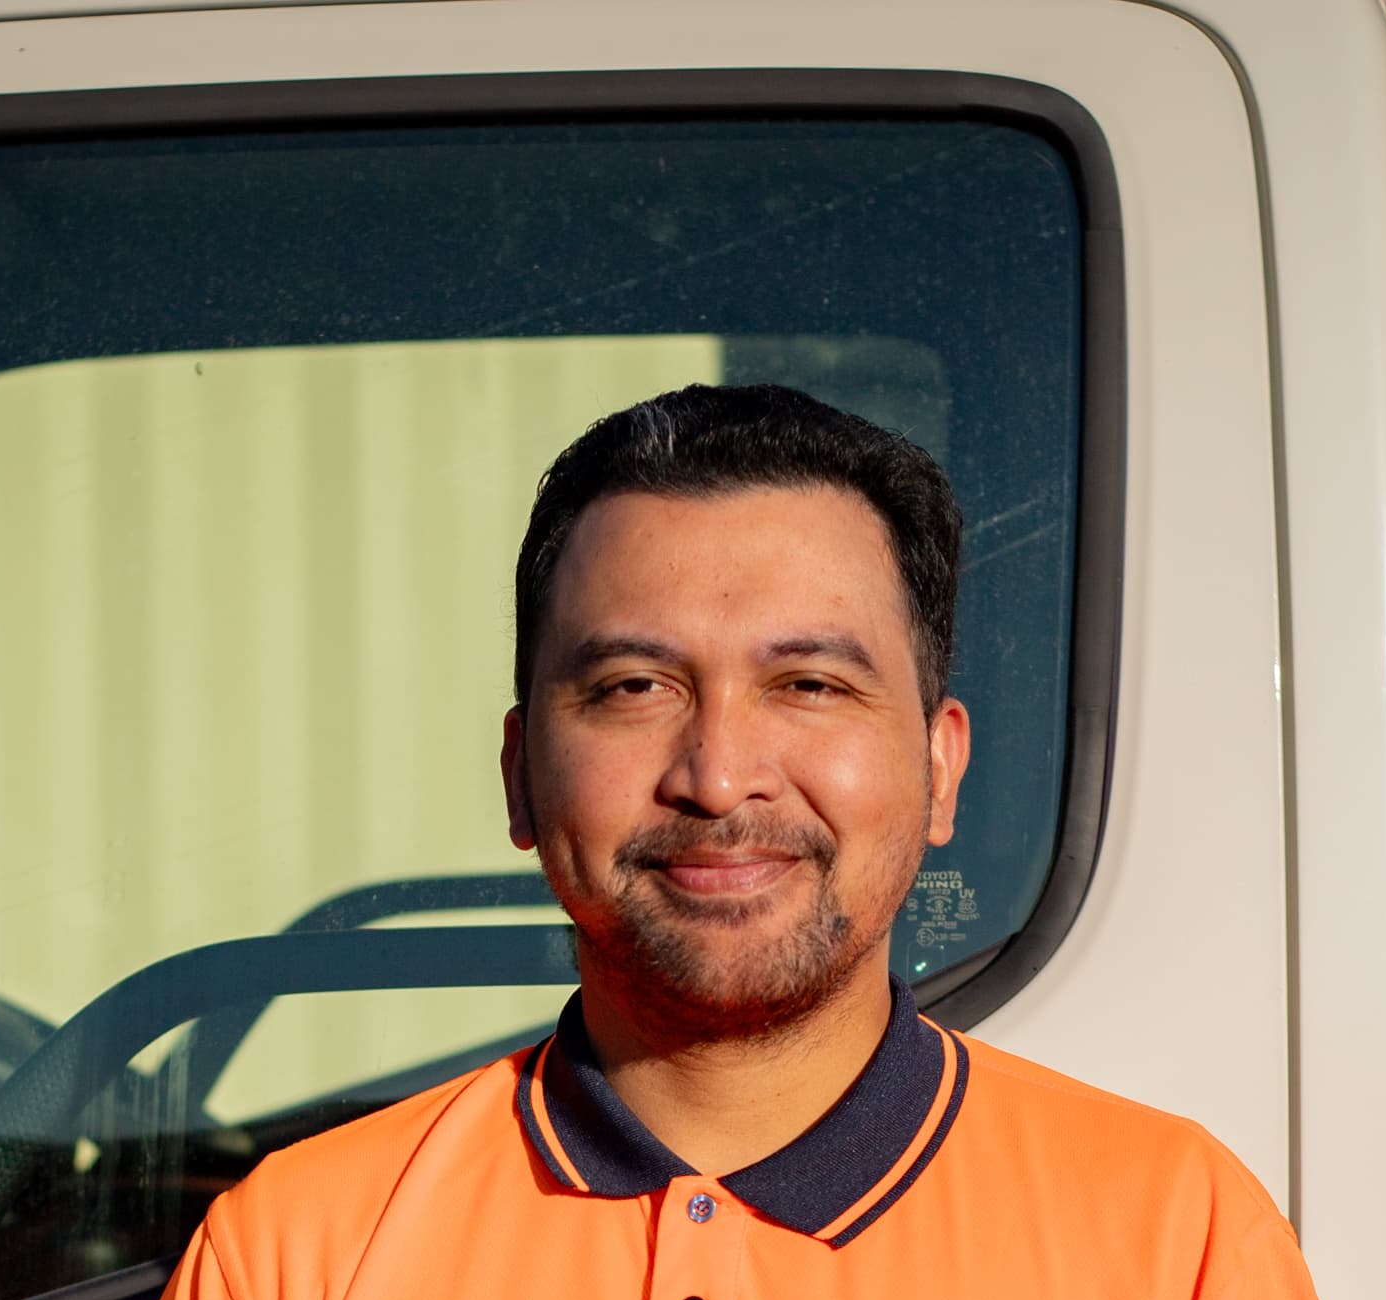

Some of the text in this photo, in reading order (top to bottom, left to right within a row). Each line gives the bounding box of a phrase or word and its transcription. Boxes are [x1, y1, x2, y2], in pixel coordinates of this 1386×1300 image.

[917, 871, 962, 880] TOYOTA
[916, 880, 963, 888] HINO
[959, 888, 975, 899] UV
